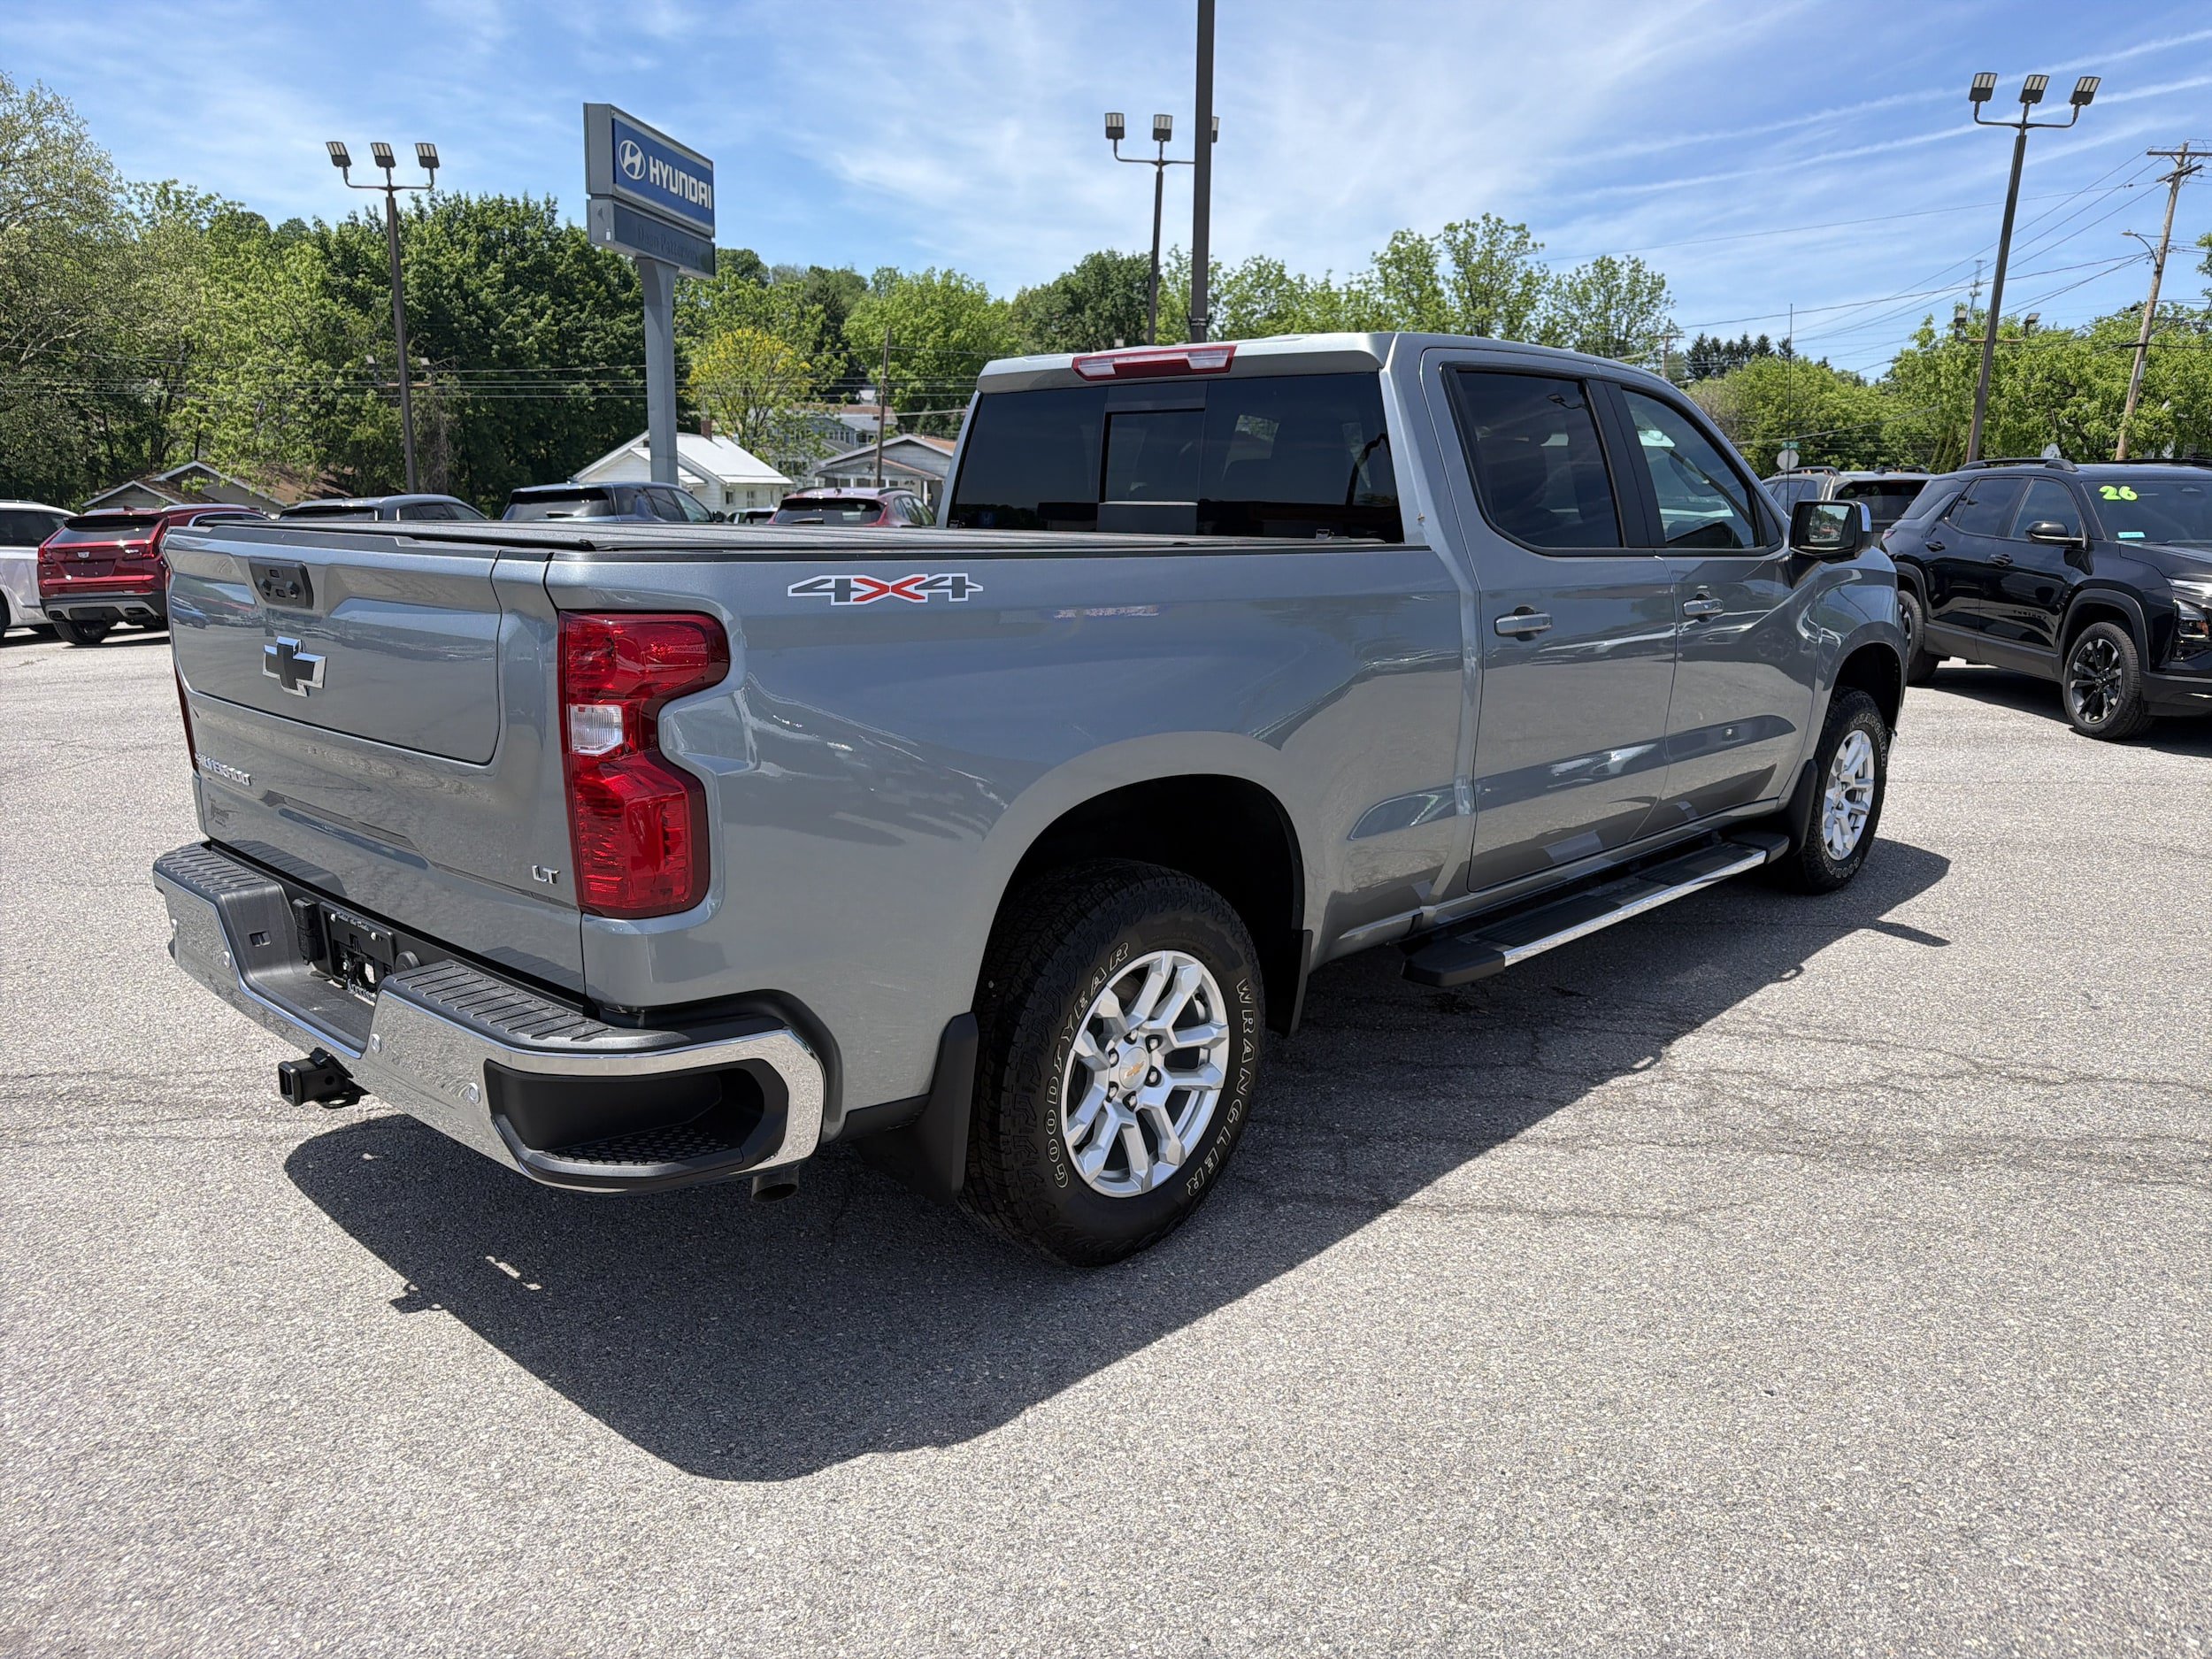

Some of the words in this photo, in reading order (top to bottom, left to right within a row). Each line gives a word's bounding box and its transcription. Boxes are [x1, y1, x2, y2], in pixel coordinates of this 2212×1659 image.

[649, 156, 712, 210] HYUNDAI
[2099, 485, 2139, 501] 26
[787, 573, 983, 605] 4X4
[195, 752, 251, 787] SILVERADO
[532, 864, 560, 885] LT
[1044, 941, 1129, 1189] GOODYEAR
[1186, 977, 1256, 1197] WRANGLER
